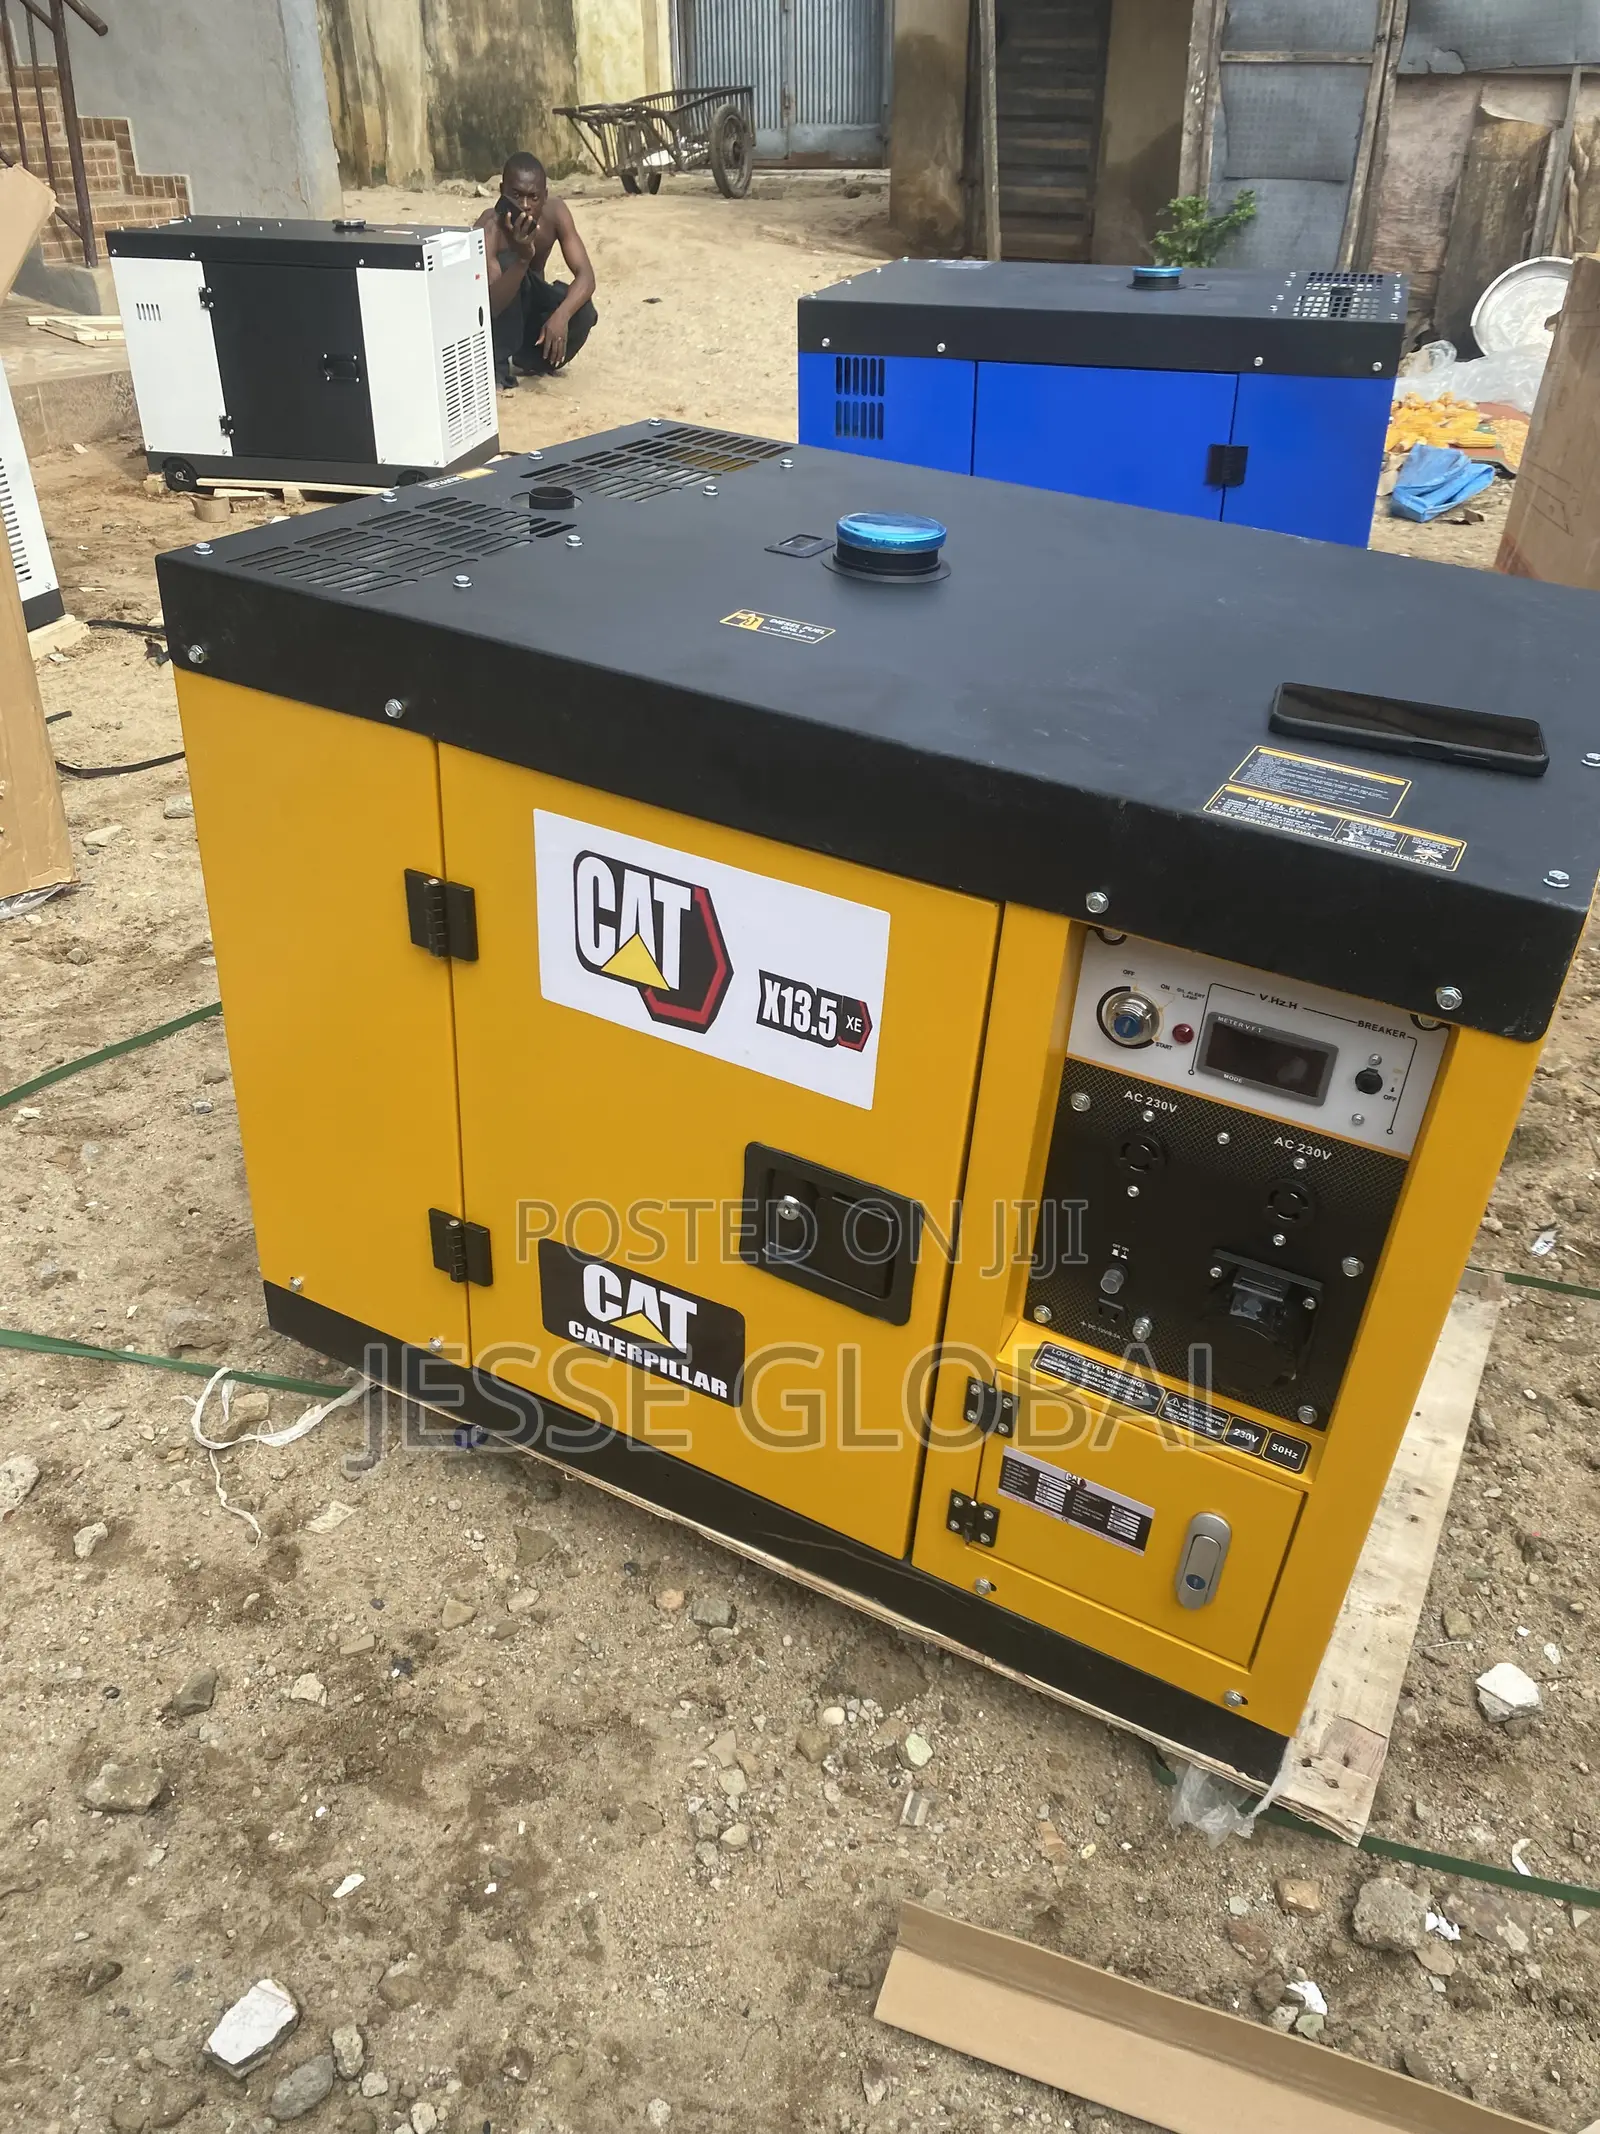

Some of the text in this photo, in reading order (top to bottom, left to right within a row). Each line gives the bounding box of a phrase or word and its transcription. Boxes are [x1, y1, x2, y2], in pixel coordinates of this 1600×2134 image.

[803, 624, 826, 635] FUEL
[1287, 806, 1318, 817] FUEL
[576, 855, 692, 990] CAT
[1160, 983, 1170, 991] ON
[762, 978, 837, 1041] X13.5
[1357, 1020, 1407, 1039] BREAKER
[1155, 1042, 1173, 1050] START
[1223, 1073, 1243, 1084] MODE
[1124, 1090, 1178, 1113] AC 230V
[1274, 1137, 1332, 1161] AC 230V
[583, 1264, 697, 1354] CAT
[568, 1320, 728, 1398] CATERPILLAR
[1051, 1348, 1146, 1389] LOW OIL LEVEL WARNING!
[1232, 1428, 1260, 1443] 230V
[1271, 1443, 1299, 1459] 50Hz
[1066, 1472, 1082, 1485] CAT
